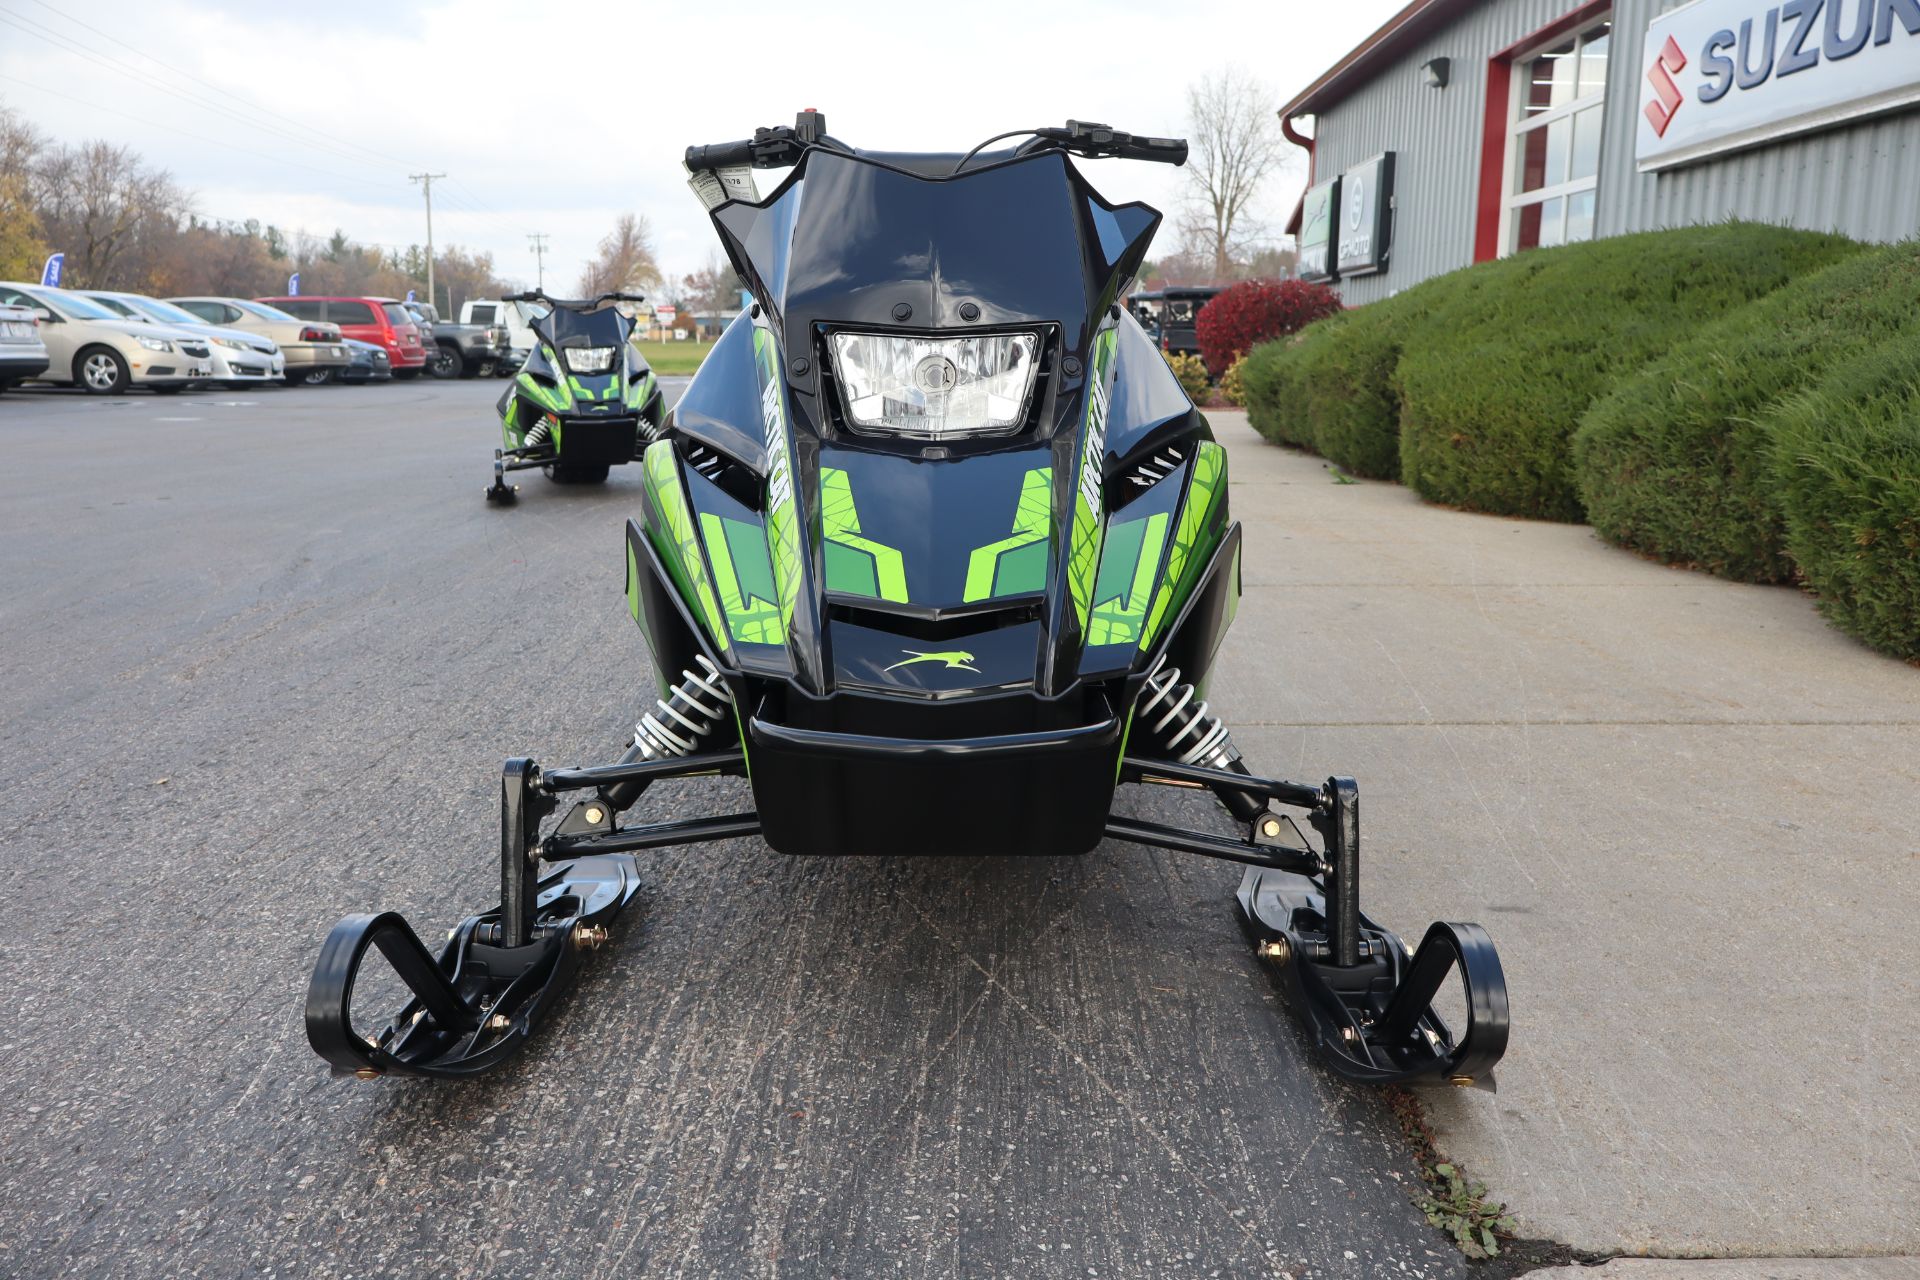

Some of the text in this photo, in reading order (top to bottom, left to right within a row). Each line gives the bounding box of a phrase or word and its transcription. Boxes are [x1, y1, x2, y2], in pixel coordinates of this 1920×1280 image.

[762, 375, 791, 517] ARCTIC CAT
[1080, 411, 1105, 525] ARCTIC
